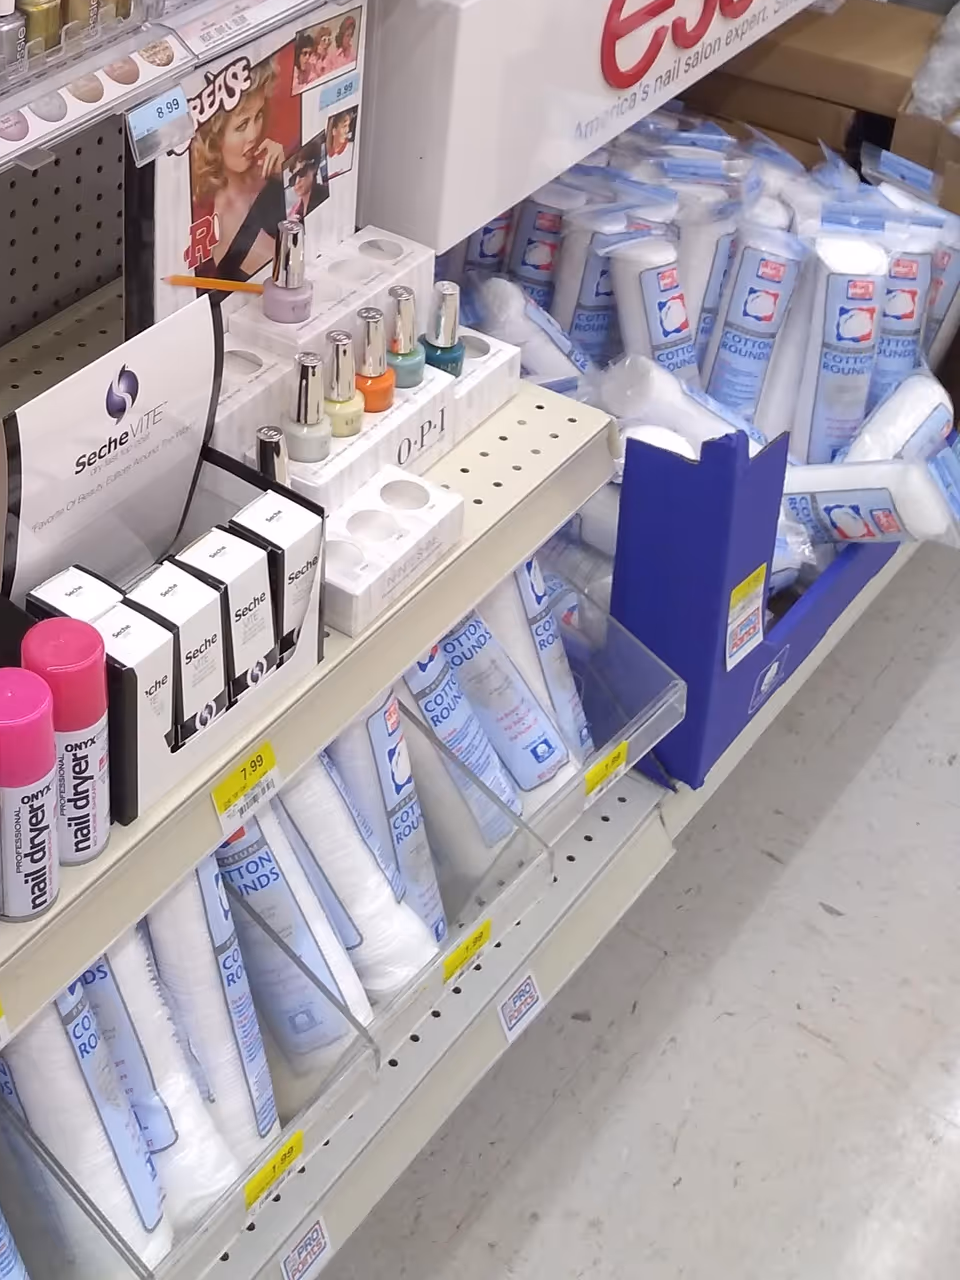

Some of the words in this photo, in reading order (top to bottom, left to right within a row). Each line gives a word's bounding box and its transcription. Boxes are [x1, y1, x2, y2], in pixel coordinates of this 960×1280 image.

[653, 63, 680, 91] nail
[683, 38, 721, 74] salon
[724, 10, 769, 46] expert.
[156, 97, 181, 120] 8.99
[188, 56, 253, 130] REASE
[73, 429, 130, 476] Seche
[128, 405, 164, 439] VITE
[66, 499, 76, 511] Of
[132, 445, 160, 472] Around
[265, 510, 283, 523] Seche
[208, 545, 227, 560] Seche
[287, 554, 318, 585] Seche
[64, 584, 84, 598] Seche
[160, 582, 178, 598] Seche
[234, 590, 266, 622] Seche
[112, 623, 132, 639] Seche
[443, 618, 484, 654] OTTON
[185, 632, 218, 665] Seche
[450, 631, 493, 669] OUNDS
[64, 736, 96, 753] ONYX
[67, 752, 94, 810] dryer
[240, 754, 264, 780] 7.99
[21, 784, 52, 805] ONYX
[58, 753, 66, 816] PROFESSIONAL
[14, 807, 23, 874] PROFESSIONAL
[23, 803, 50, 864] dryer
[67, 813, 91, 853] nail
[225, 851, 273, 883] TTON
[24, 869, 48, 911] nail
[512, 981, 532, 1008] PRO
[272, 1147, 295, 1174] 1.99
[296, 1225, 321, 1258] PRO
